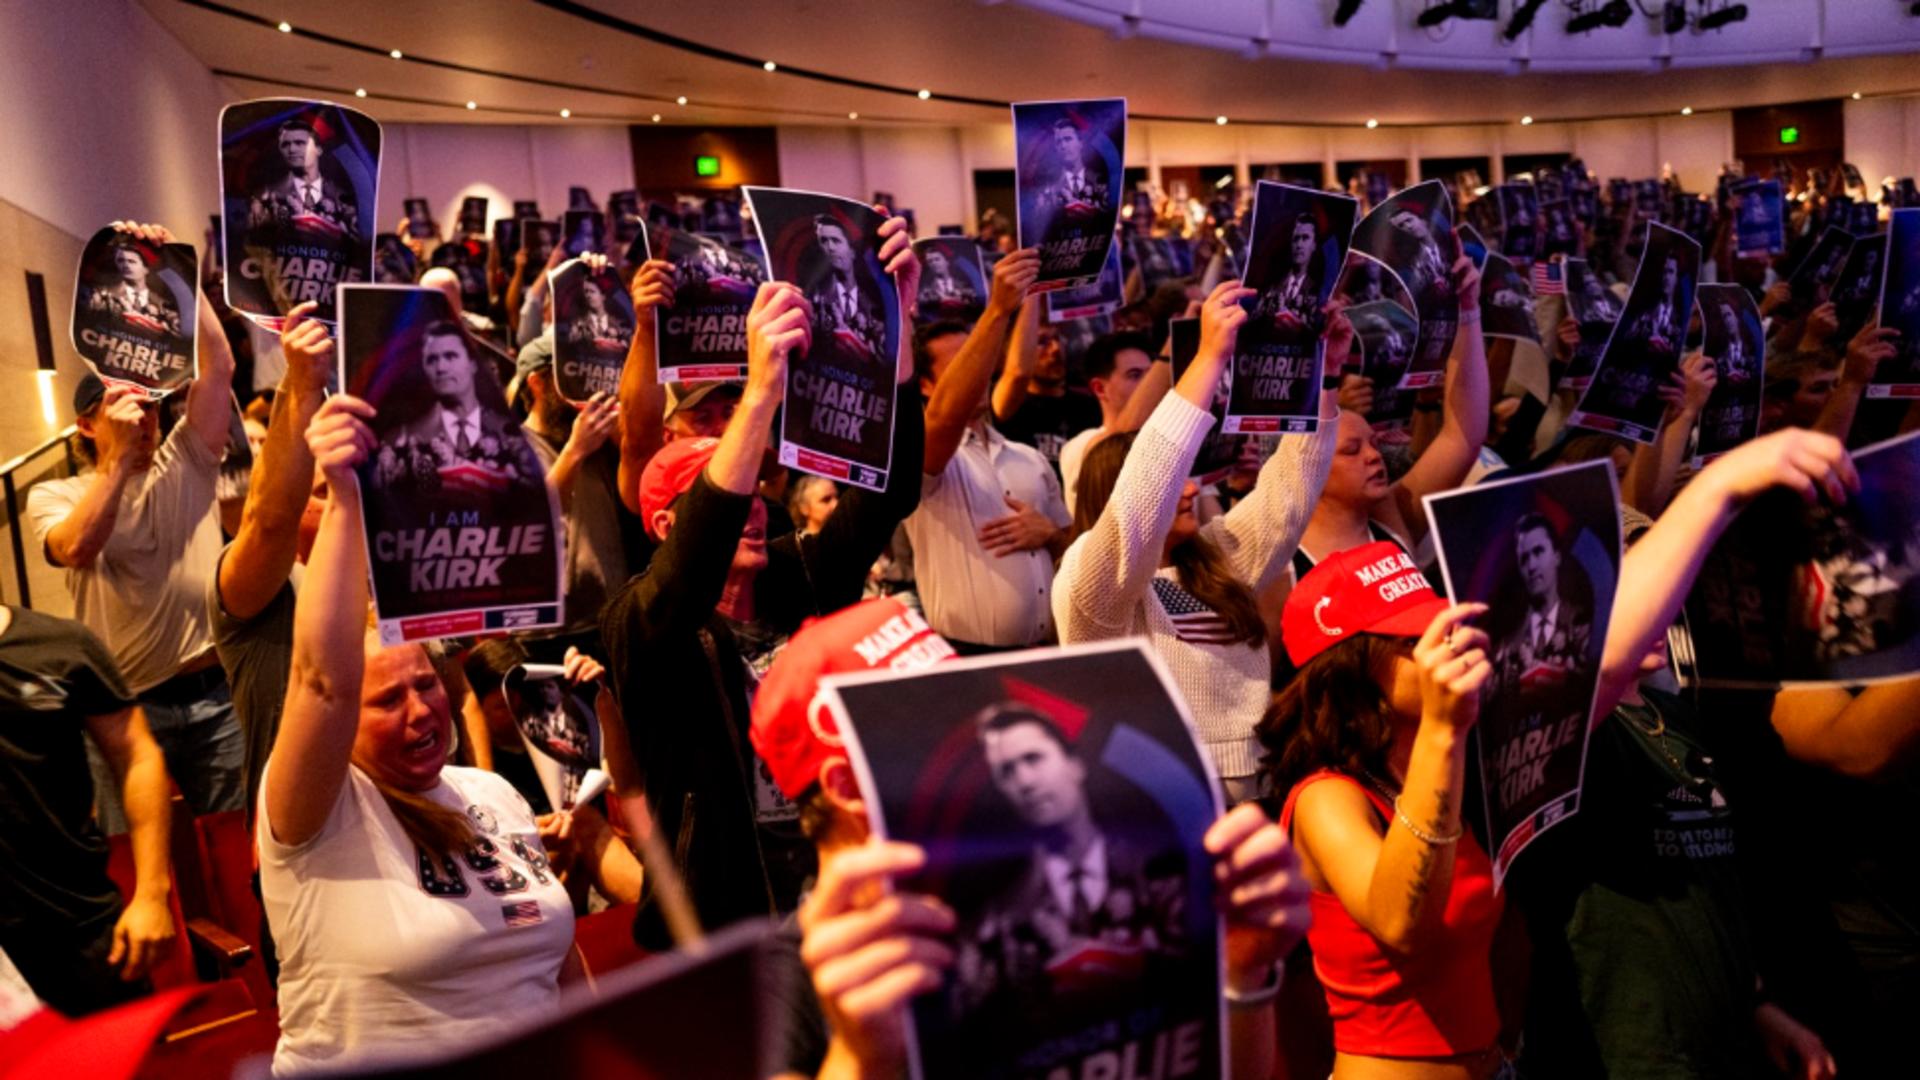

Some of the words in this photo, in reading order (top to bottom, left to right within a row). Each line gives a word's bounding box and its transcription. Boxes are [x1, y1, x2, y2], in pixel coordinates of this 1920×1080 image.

[277, 244, 328, 258] HONOR
[1043, 233, 1106, 257] HARLIE
[240, 256, 363, 284] CHARLIE
[275, 279, 335, 305] KIRK
[666, 314, 748, 336] CHARL
[81, 328, 187, 370] CHARLIE
[691, 333, 748, 353] KIRK
[104, 350, 160, 381] KIRK
[1238, 354, 1314, 379] CHARLIE
[792, 369, 887, 423] CHARLIE
[1252, 378, 1294, 401] KIRK
[810, 403, 867, 444] KIRK
[429, 511, 435, 527] I
[446, 510, 479, 526] AM
[375, 523, 546, 562] CHARLIE
[410, 556, 507, 593] KIRK
[1355, 556, 1402, 587] MAKE
[1492, 712, 1582, 779] HARLIE
[1500, 755, 1552, 810] KIRK
